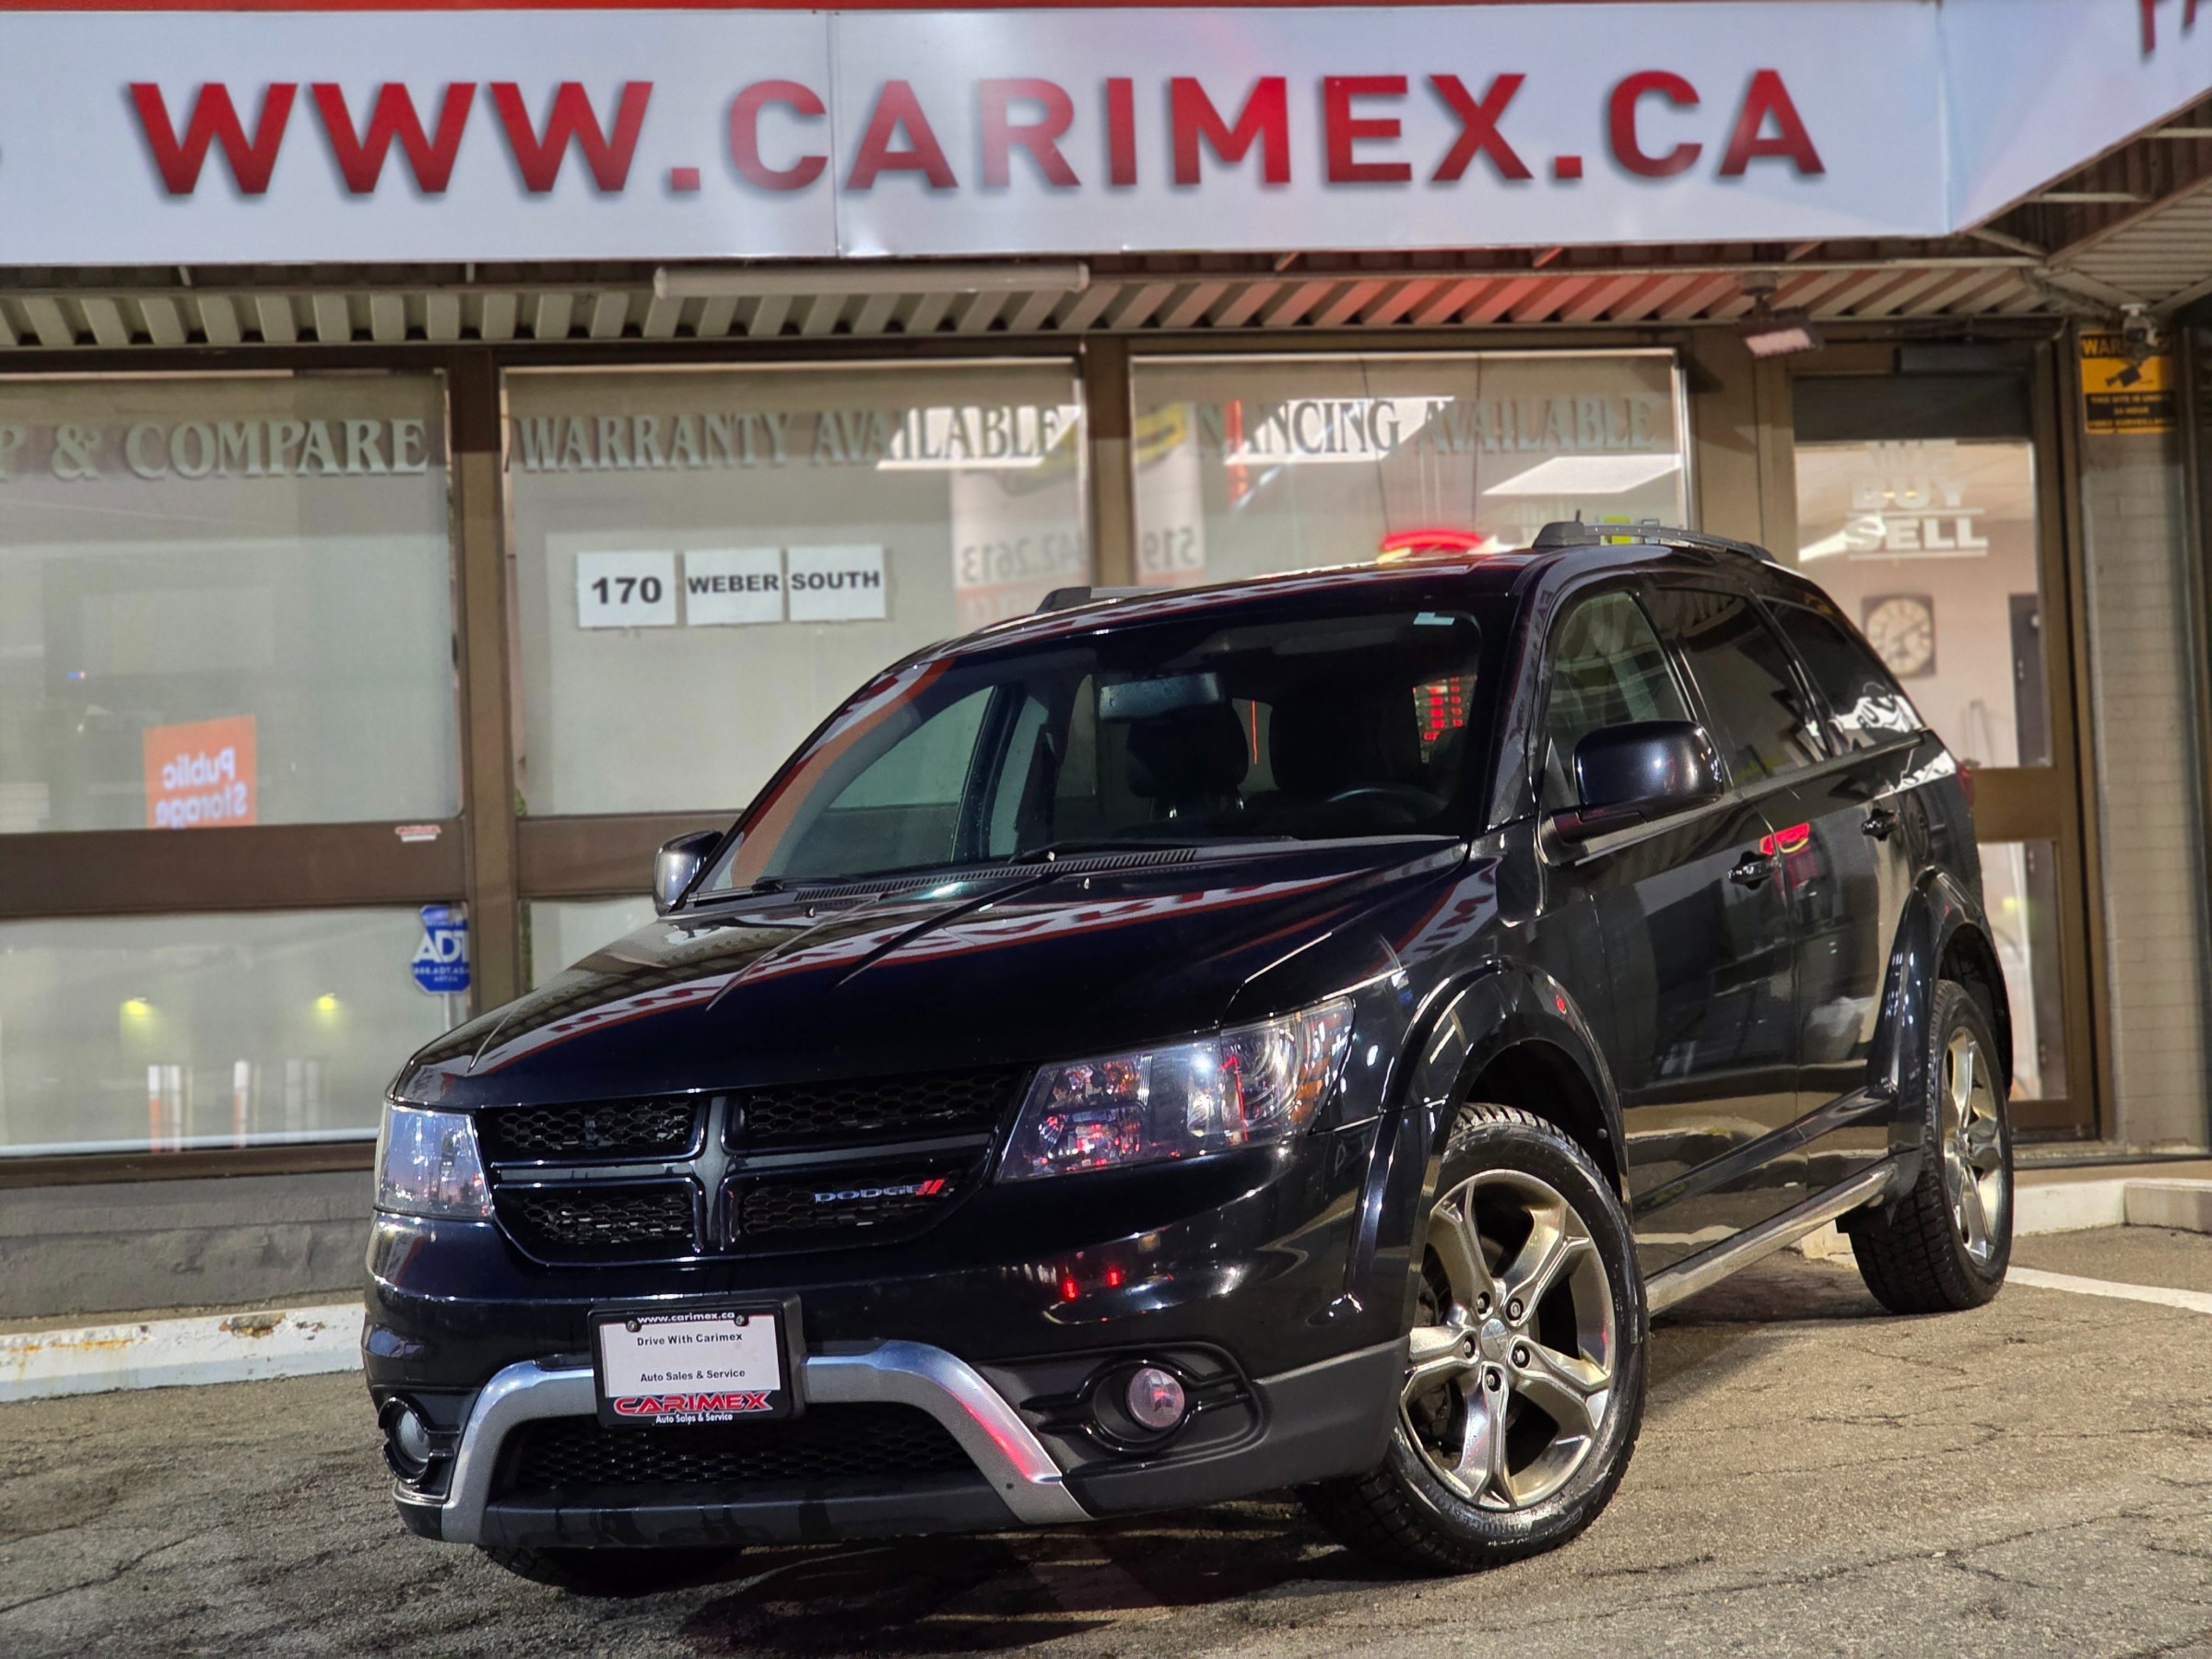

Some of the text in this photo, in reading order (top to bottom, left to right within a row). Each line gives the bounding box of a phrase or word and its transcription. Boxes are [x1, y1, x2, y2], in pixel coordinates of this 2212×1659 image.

[129, 69, 1826, 195] WWW.CARIMEX.CA
[516, 406, 1060, 472] WARRANTY AVAILABLE
[1419, 396, 1656, 454] AVAILABLE
[52, 422, 101, 480] &
[125, 418, 430, 479] COMPARE
[1852, 475, 1967, 510] BUY
[1845, 516, 1988, 551] SELL
[591, 571, 880, 605] 170 WEBER SOUTH
[412, 930, 469, 963] ADT
[815, 1184, 925, 1203] DODGE
[637, 1312, 735, 1324] www.carimex.ca
[637, 1333, 743, 1347] Drive With Carimex
[641, 1369, 746, 1382] Auto Sales & Service
[615, 1390, 772, 1416] CARIMEX
[656, 1412, 734, 1424] Auto Sales & Service
